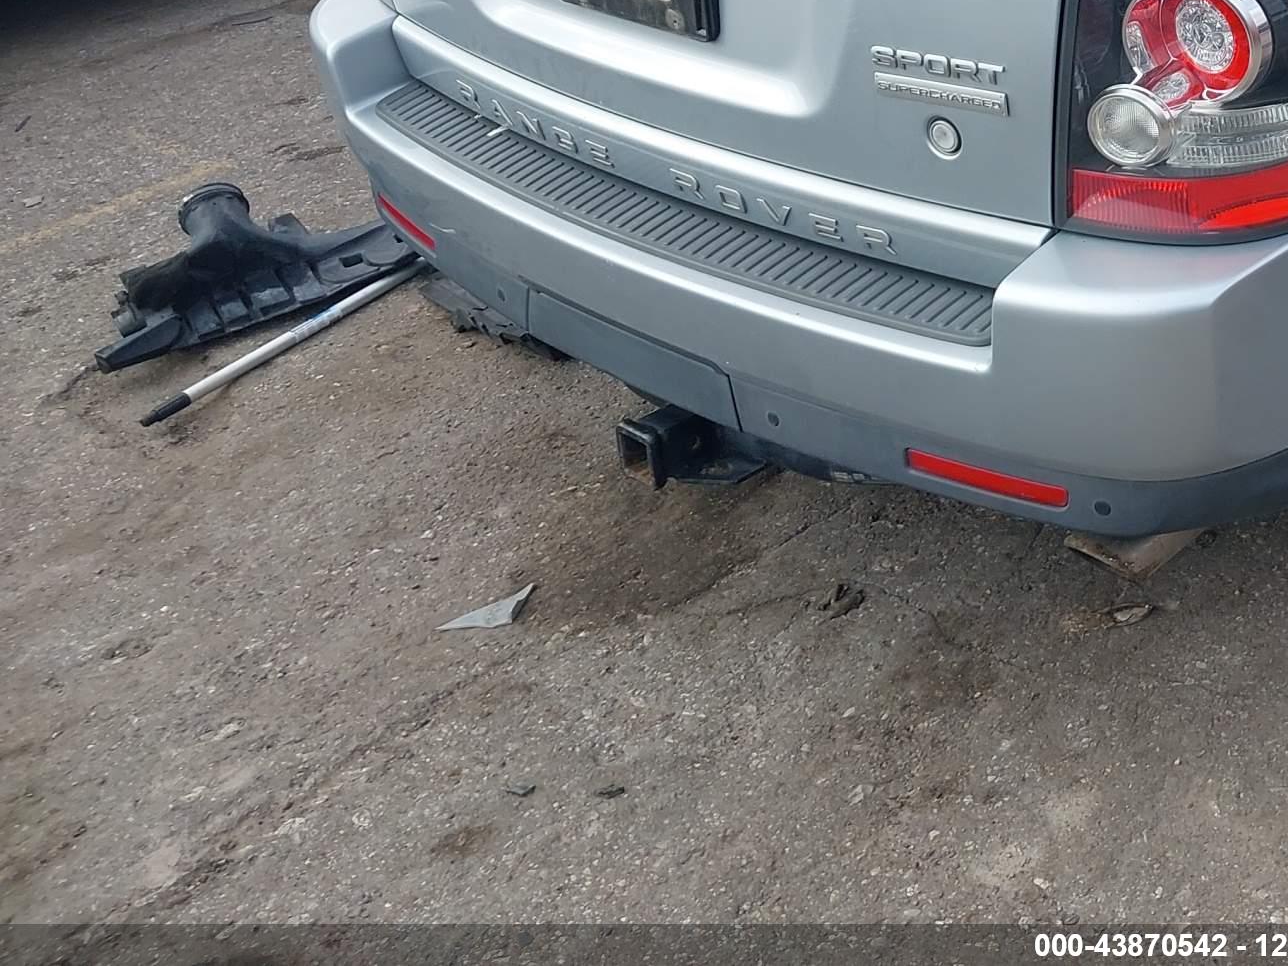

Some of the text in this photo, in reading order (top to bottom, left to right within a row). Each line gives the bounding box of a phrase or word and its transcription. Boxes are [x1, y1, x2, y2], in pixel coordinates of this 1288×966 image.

[870, 45, 1006, 85] SPORT
[877, 80, 1001, 110] SUPERCHARGED
[455, 79, 898, 256] RANGE ROVER
